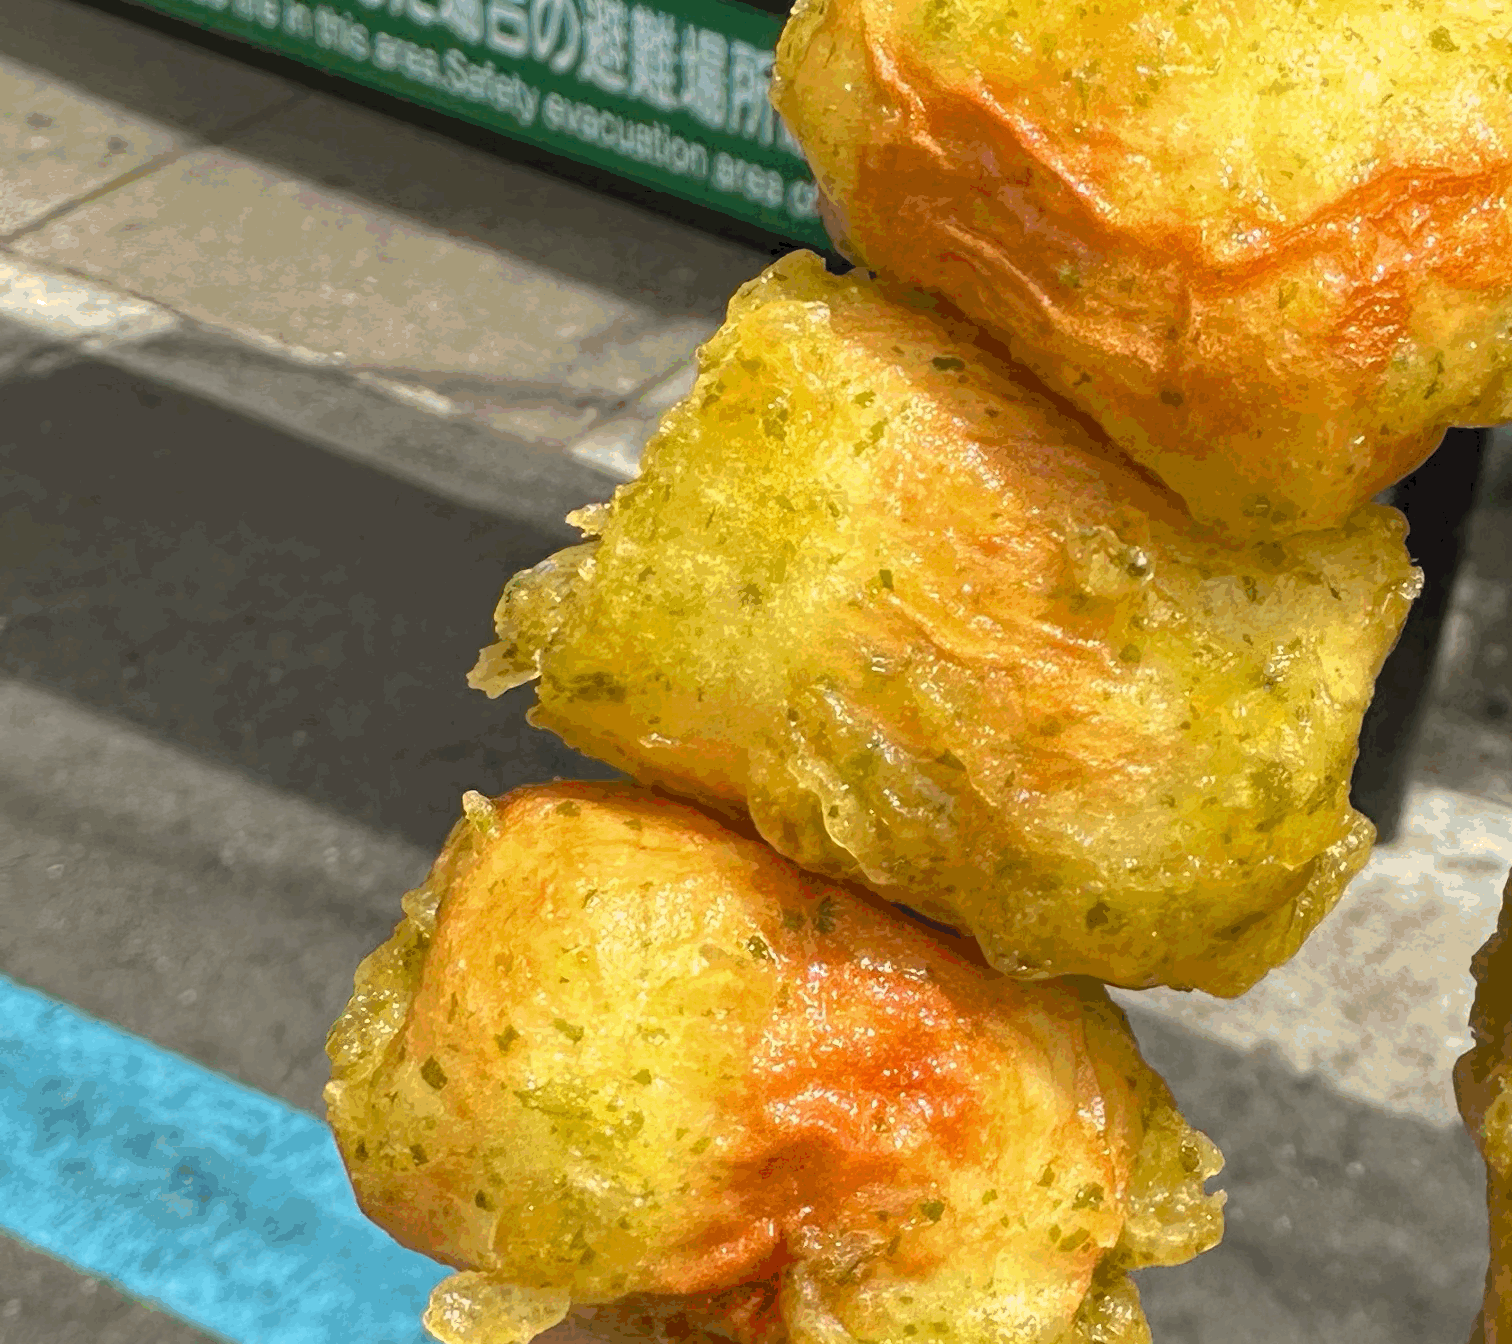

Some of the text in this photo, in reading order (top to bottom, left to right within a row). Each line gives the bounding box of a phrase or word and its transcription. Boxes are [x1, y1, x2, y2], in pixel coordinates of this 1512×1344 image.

[315, 5, 370, 60] this
[544, 93, 707, 176] evacuation
[713, 152, 783, 206] area
